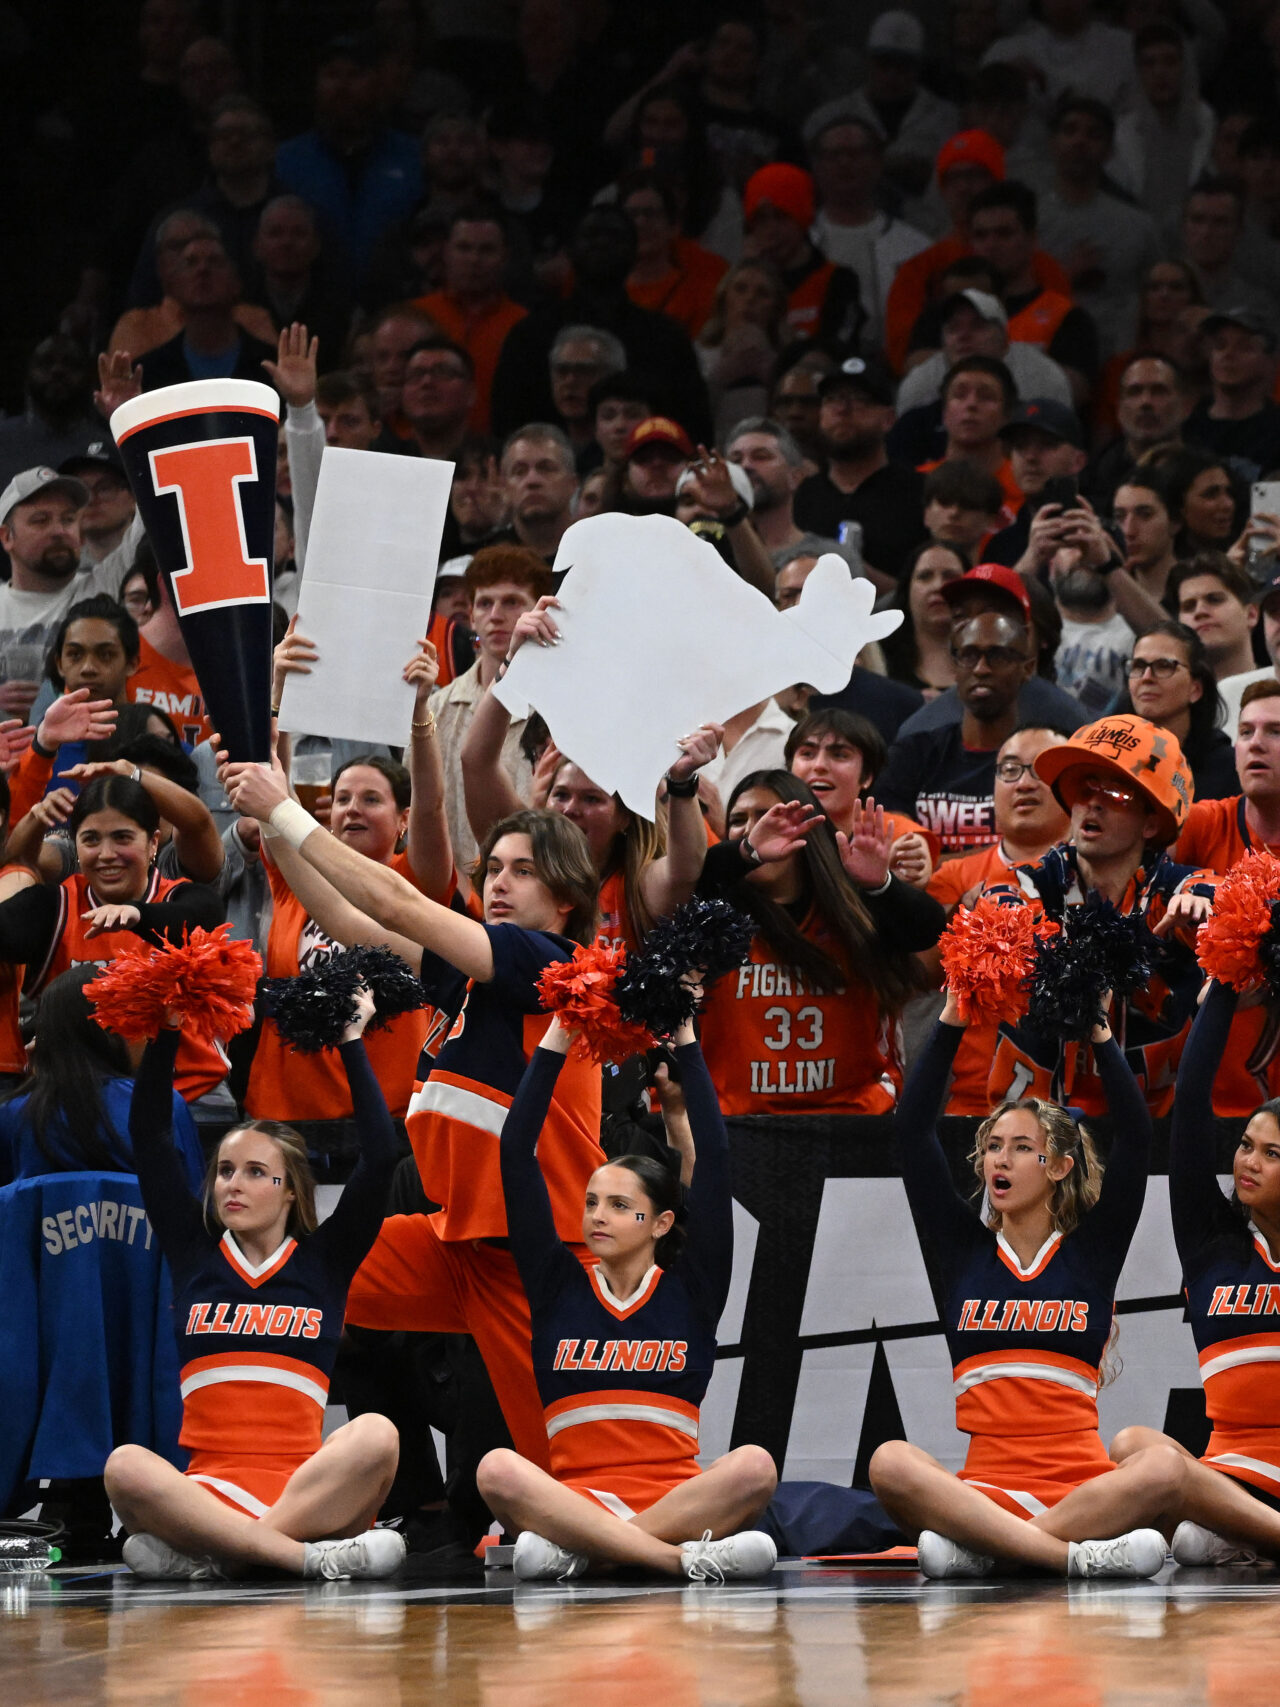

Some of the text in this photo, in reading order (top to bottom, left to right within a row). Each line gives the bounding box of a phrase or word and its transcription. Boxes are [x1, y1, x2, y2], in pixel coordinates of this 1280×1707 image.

[148, 436, 271, 617] I
[915, 799, 995, 834] SWEE
[764, 1006, 824, 1051] 33
[750, 1058, 836, 1094] ILLINI
[186, 1303, 322, 1340] ILLINOIS
[956, 1300, 1089, 1332] ILLINOIS
[553, 1339, 688, 1372] ILLINOIS
